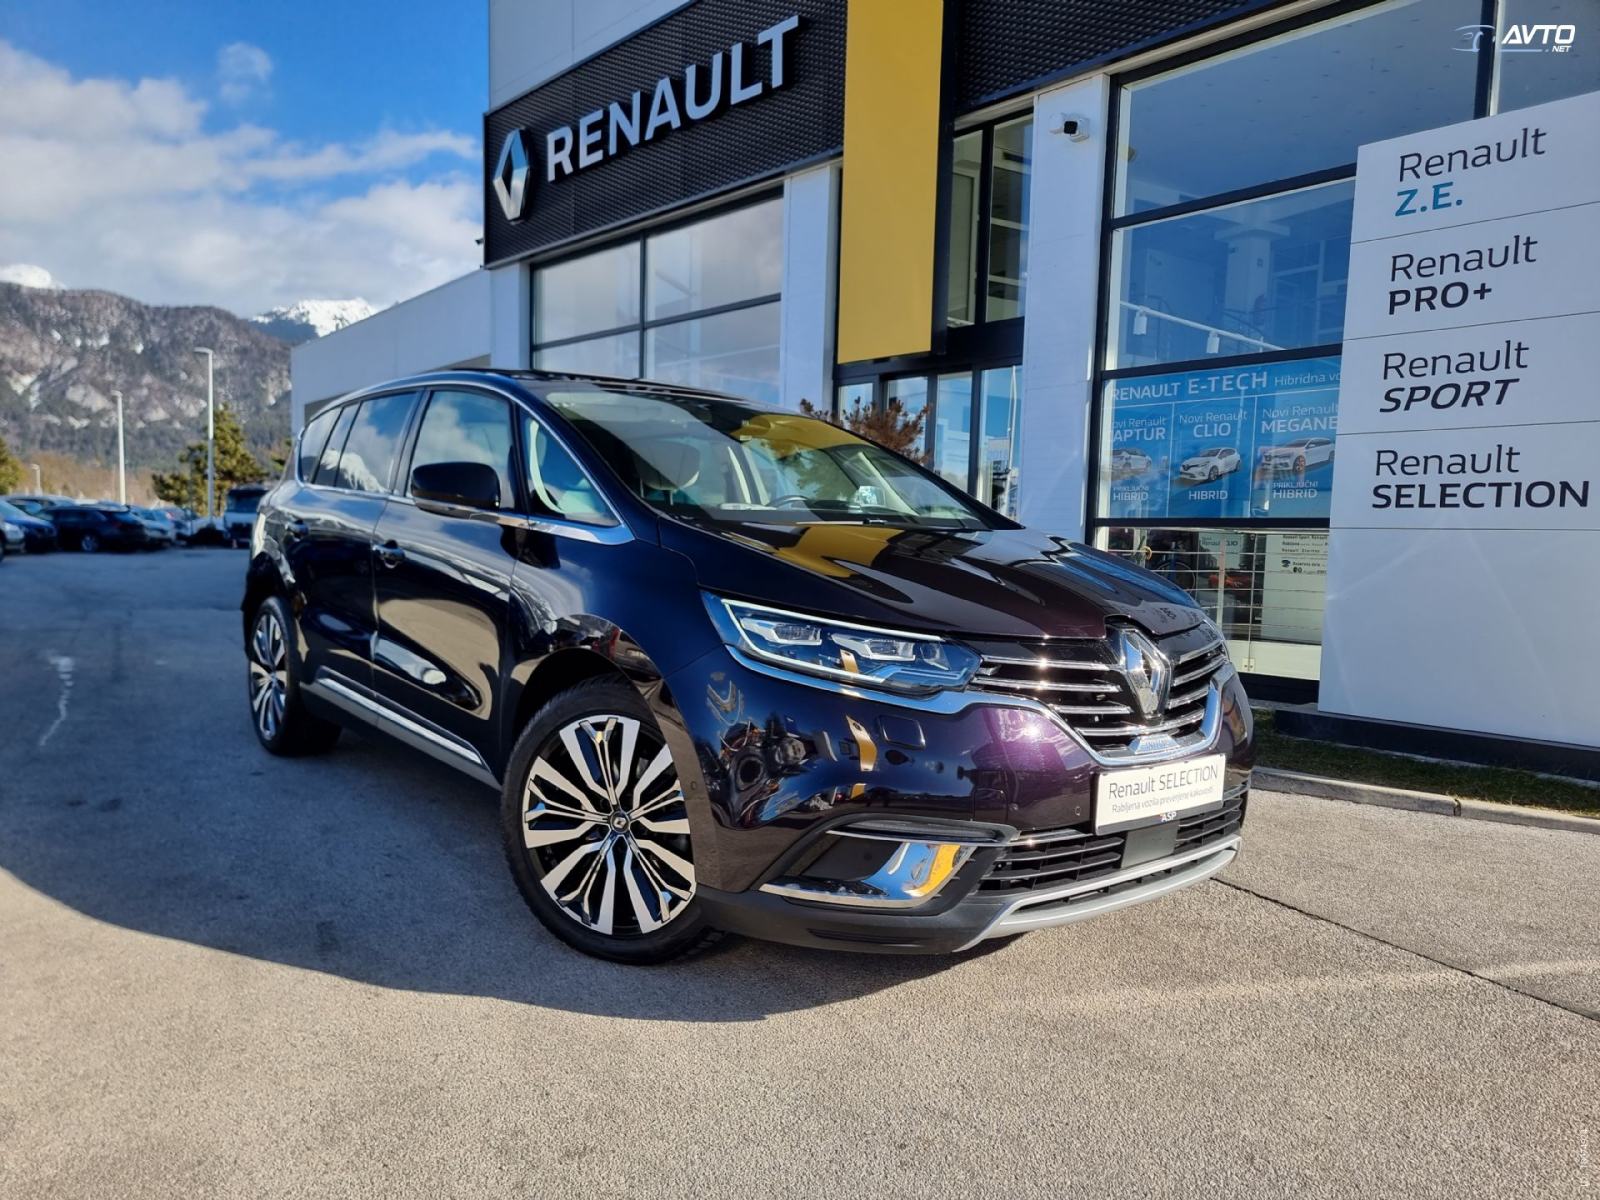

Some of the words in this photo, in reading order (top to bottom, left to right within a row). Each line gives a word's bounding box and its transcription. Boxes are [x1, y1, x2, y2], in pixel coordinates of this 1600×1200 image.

[547, 15, 799, 182] RENAULT
[1399, 127, 1547, 182] Renault
[1395, 181, 1463, 217] Z.E.
[1391, 234, 1538, 282] Renault
[1388, 281, 1492, 315] PRO+
[1383, 339, 1530, 380] Renault
[1112, 382, 1180, 401] RENAULT
[1189, 372, 1267, 394] E-TECH
[1274, 372, 1325, 387] Hibridna
[1379, 378, 1520, 413] SPORT
[1128, 415, 1166, 428] Renault
[1179, 414, 1203, 425] Novi
[1206, 408, 1247, 422] Renault
[1261, 416, 1338, 433] MEGANE
[1262, 407, 1289, 418] Novi
[1112, 427, 1166, 442] APTUR
[1193, 422, 1231, 438] CLIO
[1375, 444, 1520, 476] Renault
[1113, 491, 1149, 501] HIBRID
[1188, 490, 1228, 500] HIBRID
[1273, 488, 1318, 499] HIBRID
[1372, 480, 1590, 509] SELECTION
[1109, 776, 1155, 800] Renault
[1159, 764, 1217, 791] SELECTION
